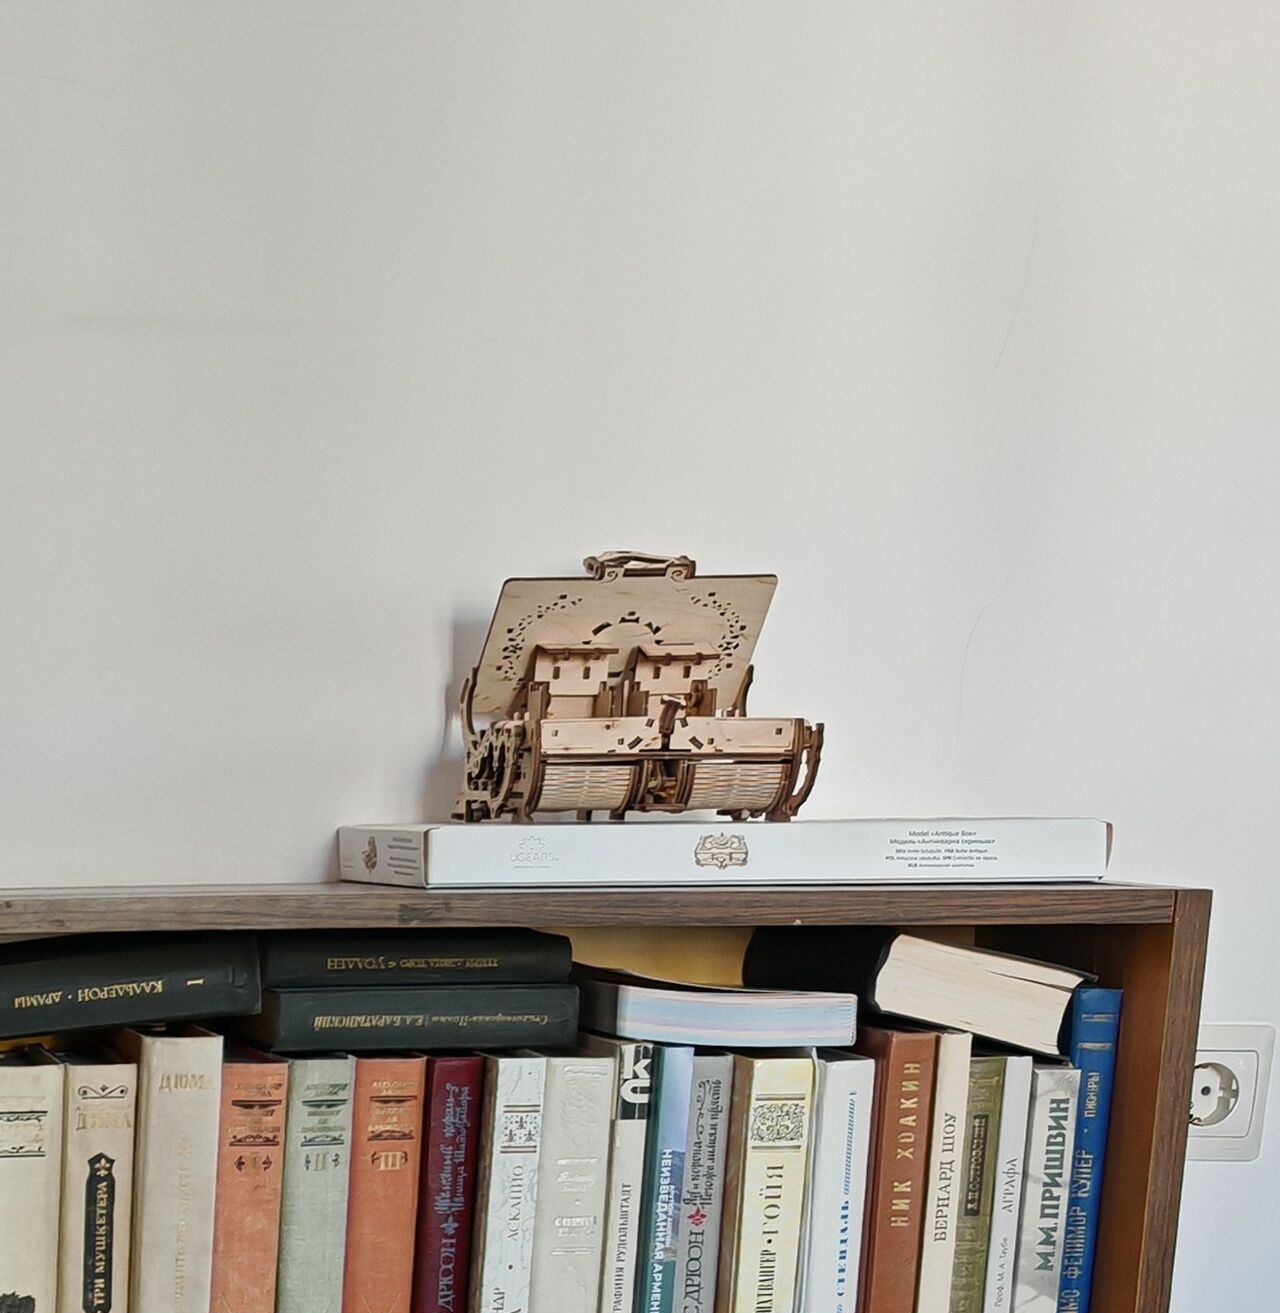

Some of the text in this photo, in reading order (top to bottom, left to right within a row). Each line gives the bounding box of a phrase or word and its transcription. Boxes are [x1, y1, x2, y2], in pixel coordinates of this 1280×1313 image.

[15, 979, 163, 1008] КАЛЬДЕРОН ДРАМЫ
[889, 1062, 921, 1228] НИК ХОАКИН
[932, 1112, 958, 1242] БЕРНАРД ШОУ
[92, 1182, 109, 1306] ТРИ МУШКЕТЕРА
[649, 1148, 673, 1260] НЕИЗВЕДАННАЯ
[760, 1164, 785, 1236] ГОЙЯ
[436, 1236, 458, 1311] ДРЮОН
[683, 1229, 705, 1303] ДРЮОН
